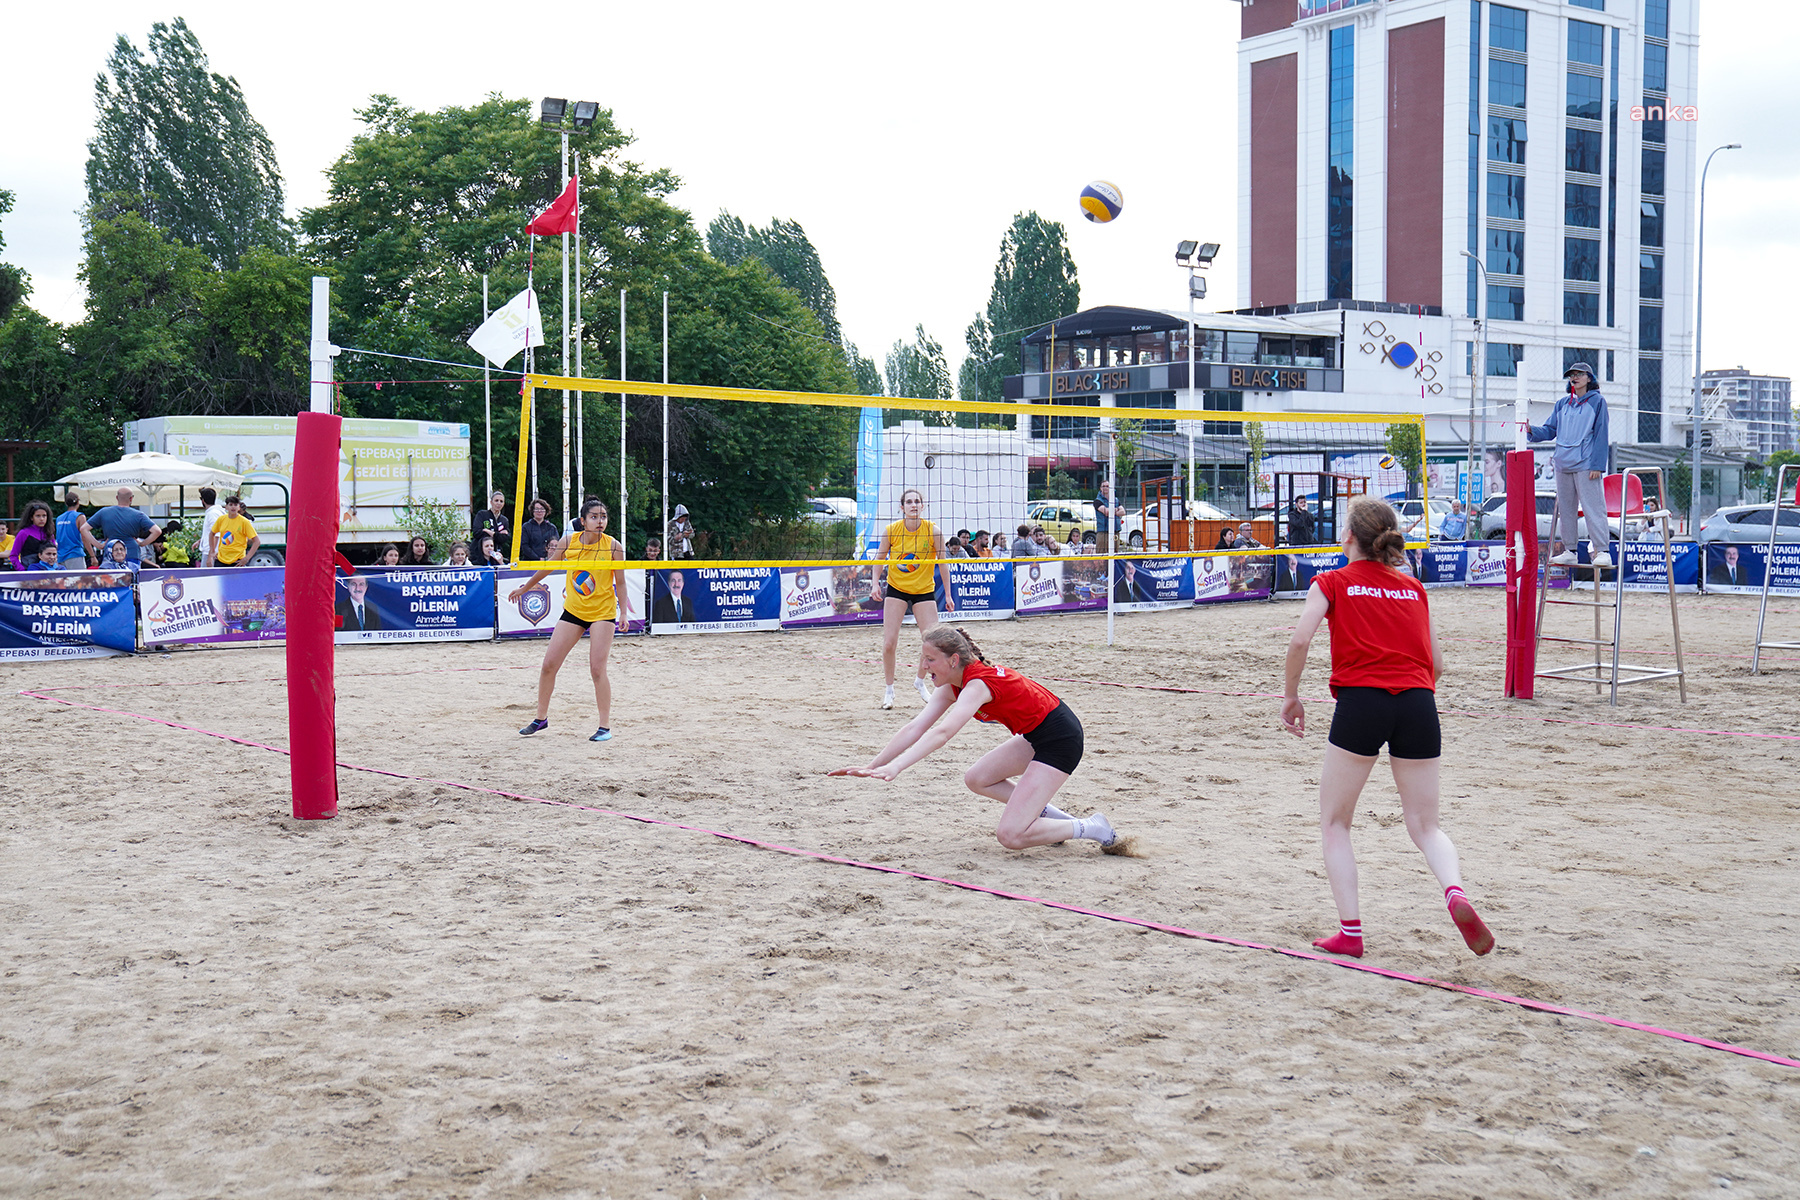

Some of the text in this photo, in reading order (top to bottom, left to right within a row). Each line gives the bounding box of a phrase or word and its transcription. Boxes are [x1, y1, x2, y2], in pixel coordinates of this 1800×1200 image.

[353, 447, 466, 461] TEPEBAŞI BELEDİYESİ
[355, 465, 390, 478] GEZİCİ
[433, 467, 466, 478] ARACI
[1637, 545, 1689, 553] TAKIMARA
[697, 567, 771, 579] TÜM TAKIMLARA
[959, 562, 1005, 572] TAKIMLARA
[385, 570, 482, 583] TÜM TAKIMLARA
[951, 574, 996, 585] BAŞARILAR
[402, 585, 467, 598] BAŞARILAR
[710, 581, 760, 593] BAŞARILAR
[957, 586, 991, 597] DİLERİM
[1347, 585, 1419, 601] BEACH VOLLEY
[1, 588, 119, 602] TÜM TAKIMLARA
[716, 593, 755, 606] DİLERİM
[22, 604, 101, 618] BAŞARILAR
[410, 599, 460, 612] DİLERİM
[415, 615, 440, 624] Ahmet
[31, 620, 92, 635] DİLERİM
[418, 630, 463, 638] BELEDİYESİ
[44, 647, 96, 656] BELEDİYESİ
